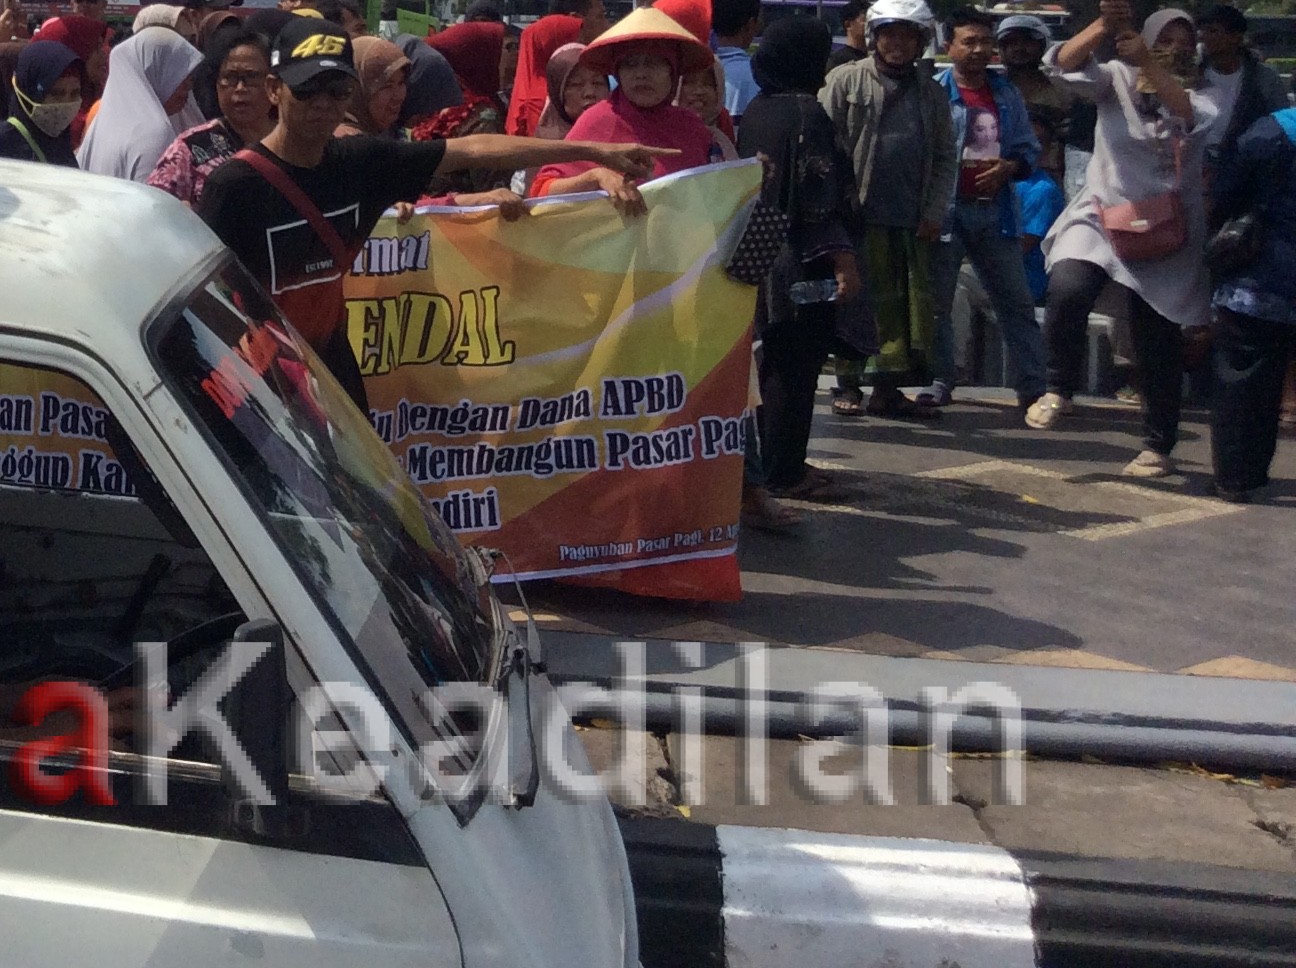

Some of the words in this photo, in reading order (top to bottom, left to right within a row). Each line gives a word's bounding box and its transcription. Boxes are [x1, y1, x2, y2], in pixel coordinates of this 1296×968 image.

[291, 34, 346, 58] 46
[396, 400, 510, 440] Dengan
[518, 389, 590, 431] Dana
[602, 375, 684, 416] APBD
[407, 435, 597, 481] Membangun
[607, 425, 695, 468] Pasar
[559, 543, 633, 561] Paguyuban
[637, 536, 671, 553] Pasar
